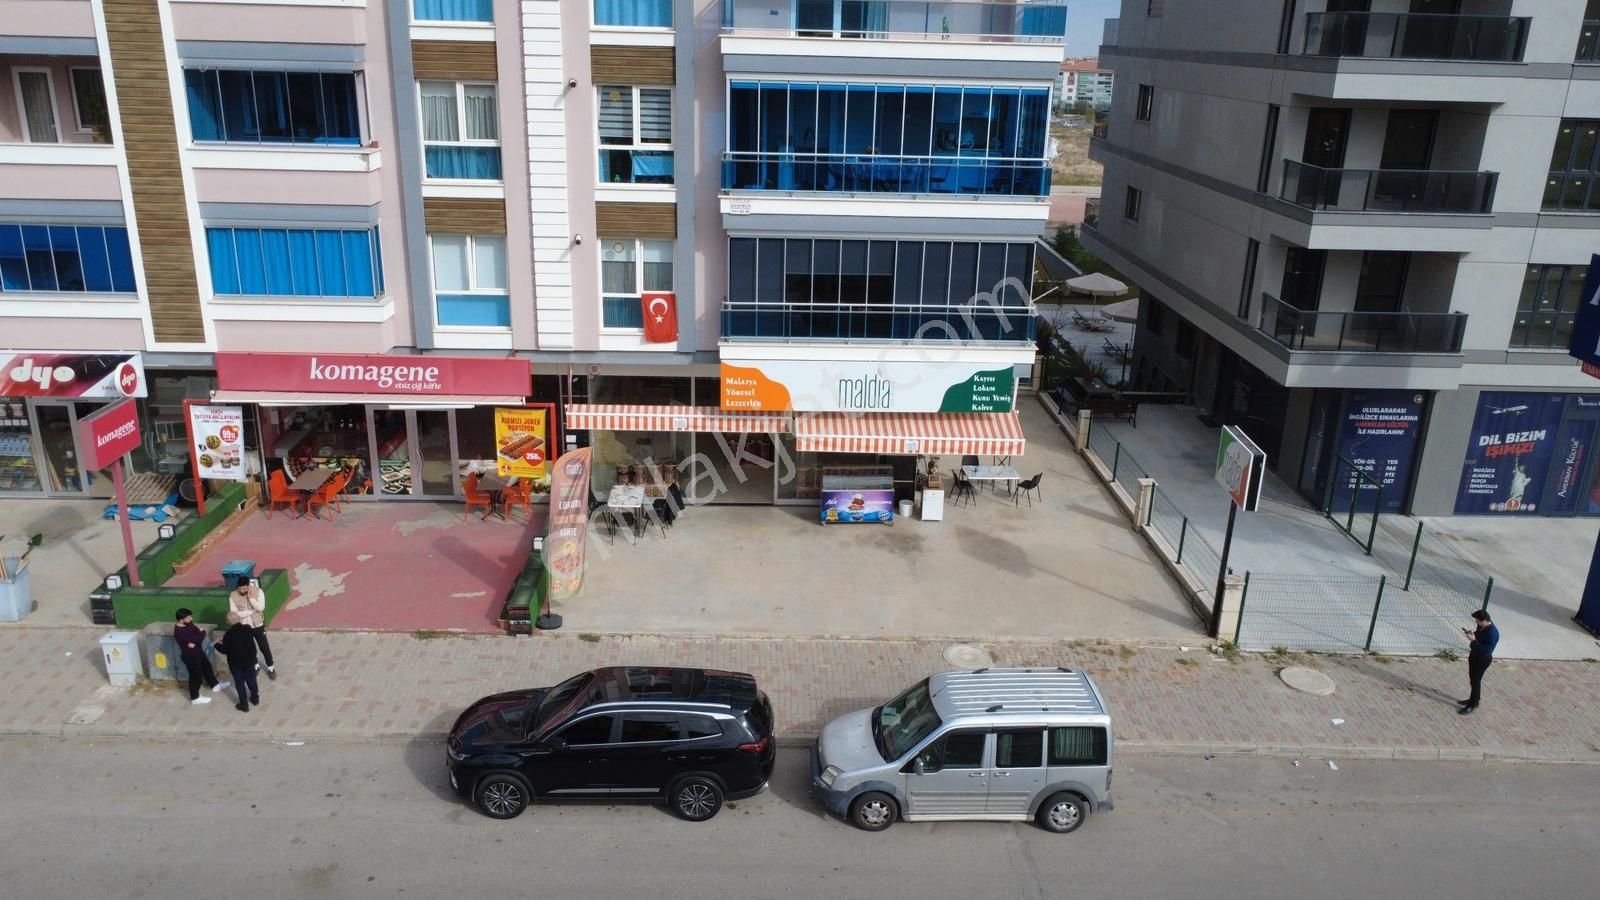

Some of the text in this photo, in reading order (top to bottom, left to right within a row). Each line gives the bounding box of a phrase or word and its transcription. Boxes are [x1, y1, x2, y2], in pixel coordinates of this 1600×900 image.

[10, 358, 75, 390] dyo
[121, 373, 136, 387] dyo
[310, 357, 439, 388] komagene
[423, 381, 442, 391] köfte
[838, 374, 892, 409] maldia
[97, 420, 136, 448] komagene
